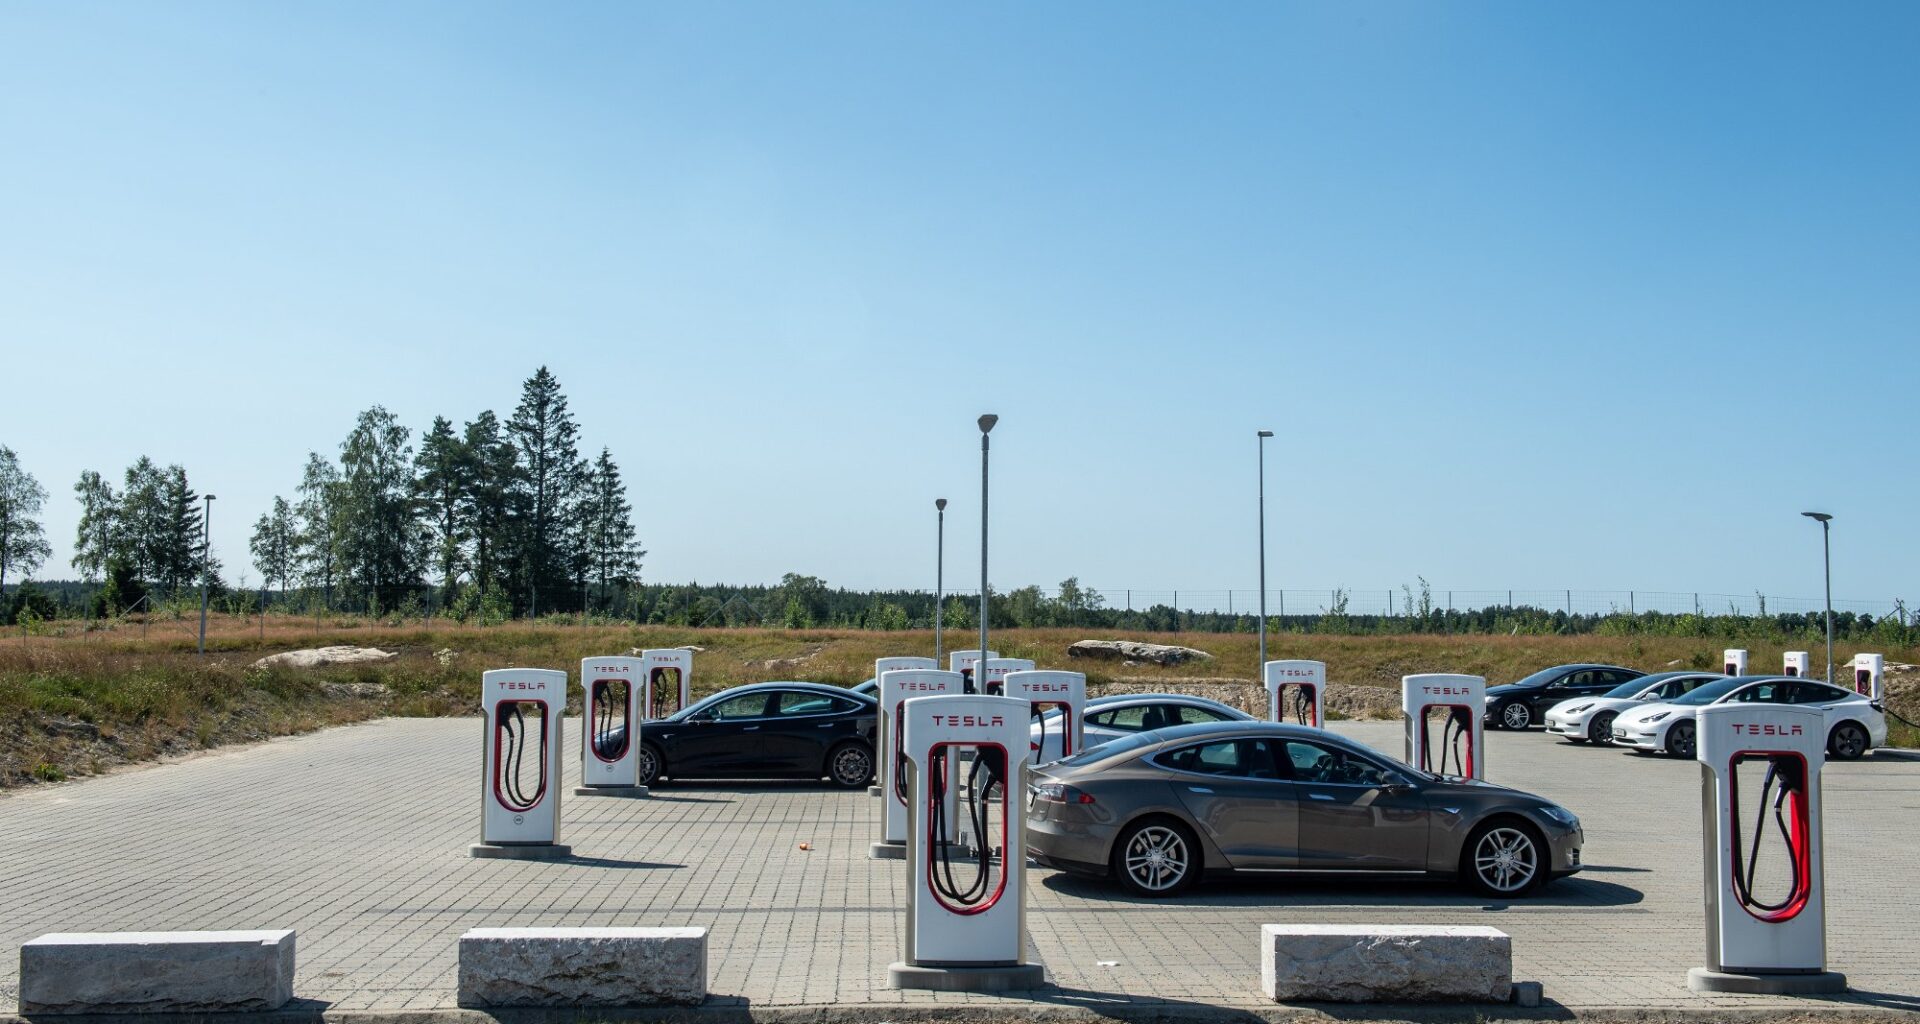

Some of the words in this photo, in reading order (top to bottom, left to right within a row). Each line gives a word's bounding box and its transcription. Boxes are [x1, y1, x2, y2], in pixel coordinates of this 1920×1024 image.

[498, 682, 546, 690] TESLA
[898, 682, 946, 690] TESLA
[1021, 683, 1069, 692] TESLA
[1422, 686, 1470, 695] TESLA
[931, 715, 1004, 727] TESLA
[1731, 723, 1803, 736] TESLA
